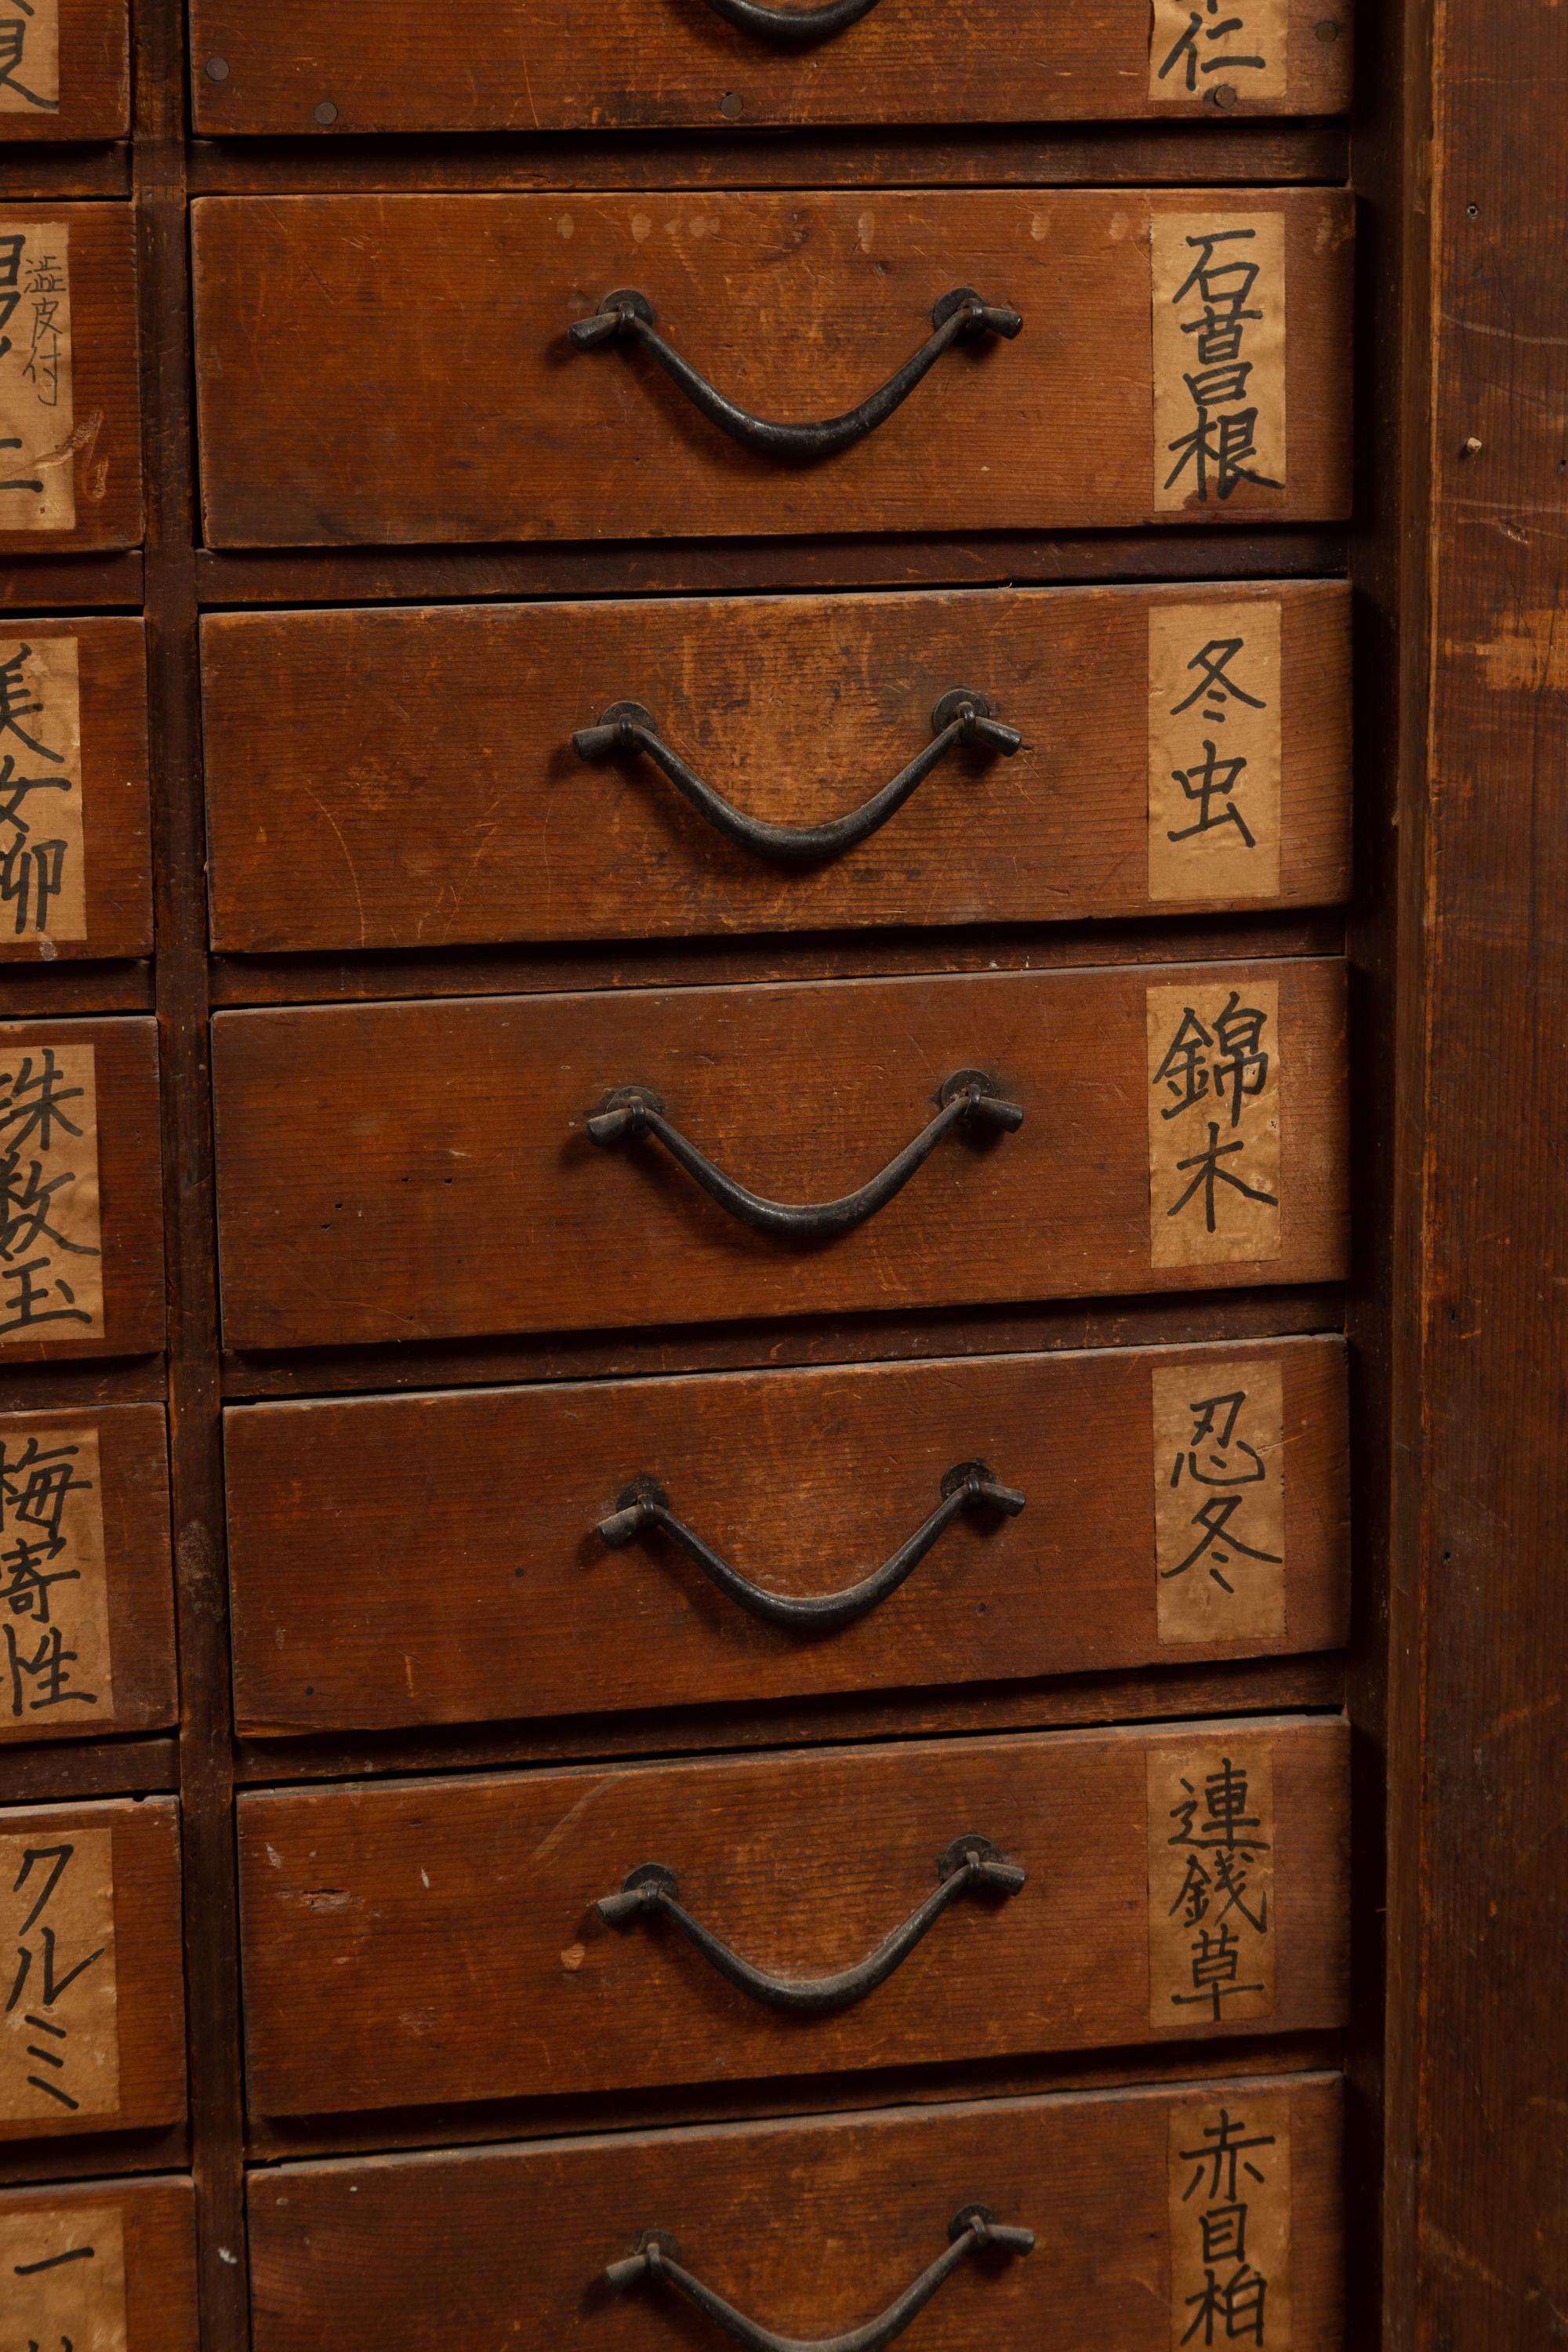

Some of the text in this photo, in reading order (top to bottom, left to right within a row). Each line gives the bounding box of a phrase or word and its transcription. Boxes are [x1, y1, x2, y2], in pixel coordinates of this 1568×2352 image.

[1158, 0, 1267, 92] 仁
[1163, 229, 1285, 502] 石菖根
[1167, 637, 1267, 848] 冬虫
[1152, 991, 1279, 1233] 錦木
[1160, 1391, 1283, 1593] 忍冬
[5, 1843, 107, 2111] クルミ
[1179, 2108, 1276, 2347] 赤目柏
